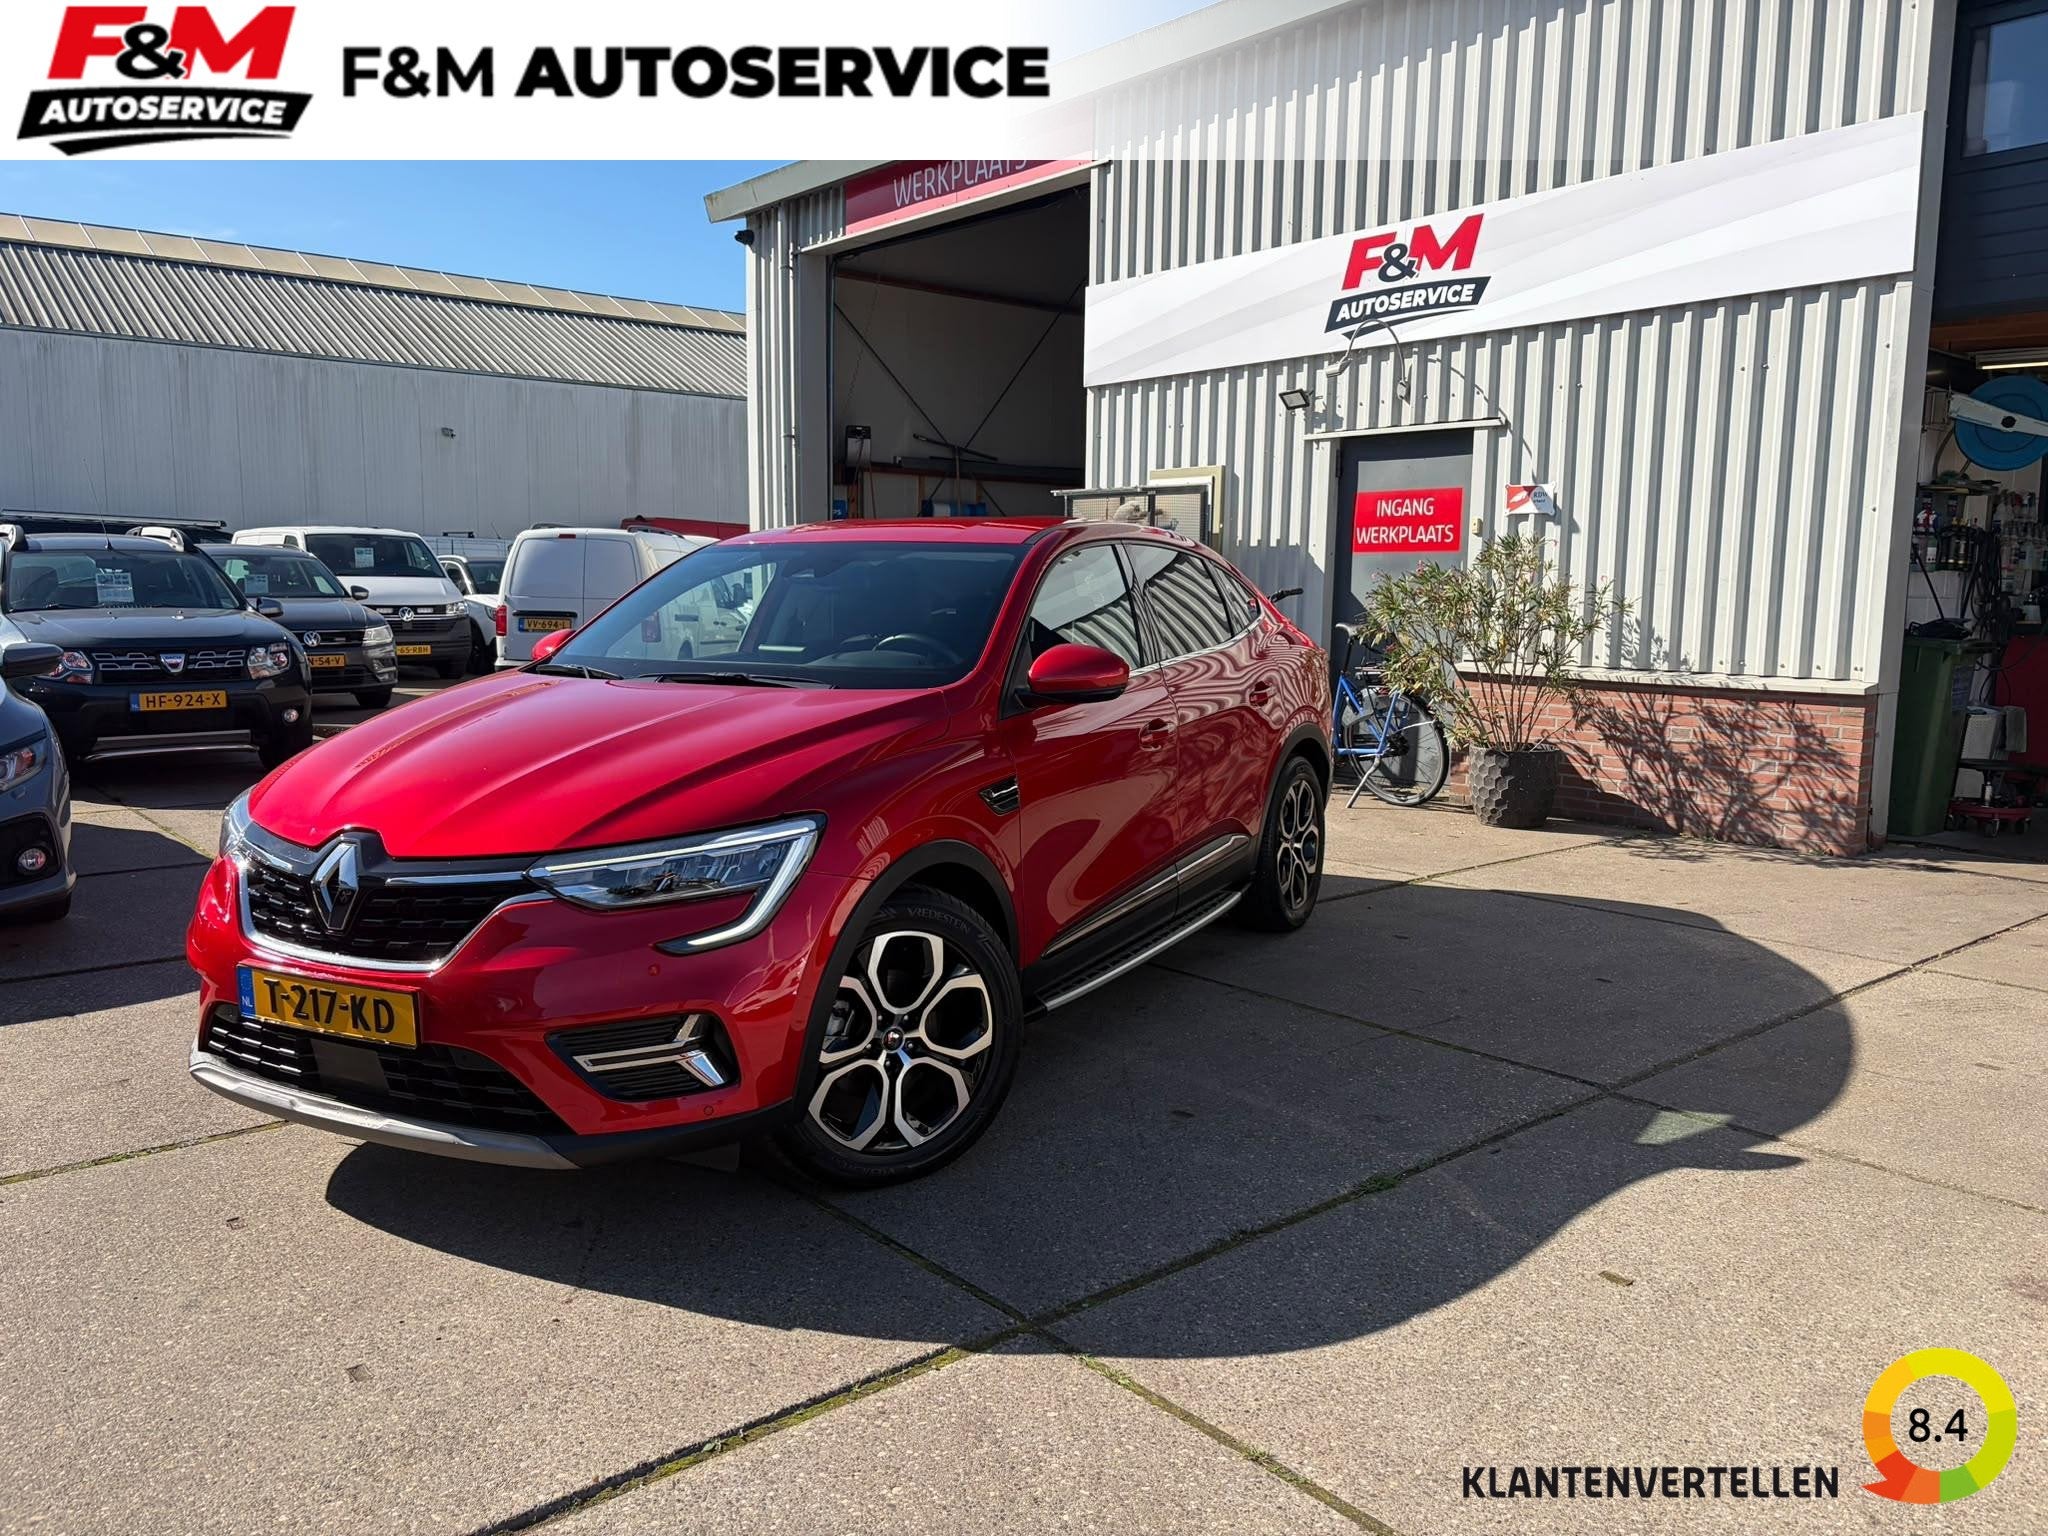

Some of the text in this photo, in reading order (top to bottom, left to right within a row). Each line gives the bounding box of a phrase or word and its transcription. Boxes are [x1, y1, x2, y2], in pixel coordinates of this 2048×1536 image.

[894, 160, 1026, 207] WERKPLAA
[1342, 213, 1485, 290] F&M
[1335, 283, 1477, 322] AUTOSERVICE
[1376, 497, 1435, 517] INGANG
[1356, 524, 1454, 544] WERKPLAATS
[145, 692, 221, 708] HF-924-X
[241, 995, 254, 1008] NL
[263, 978, 395, 1034] T-217-KD
